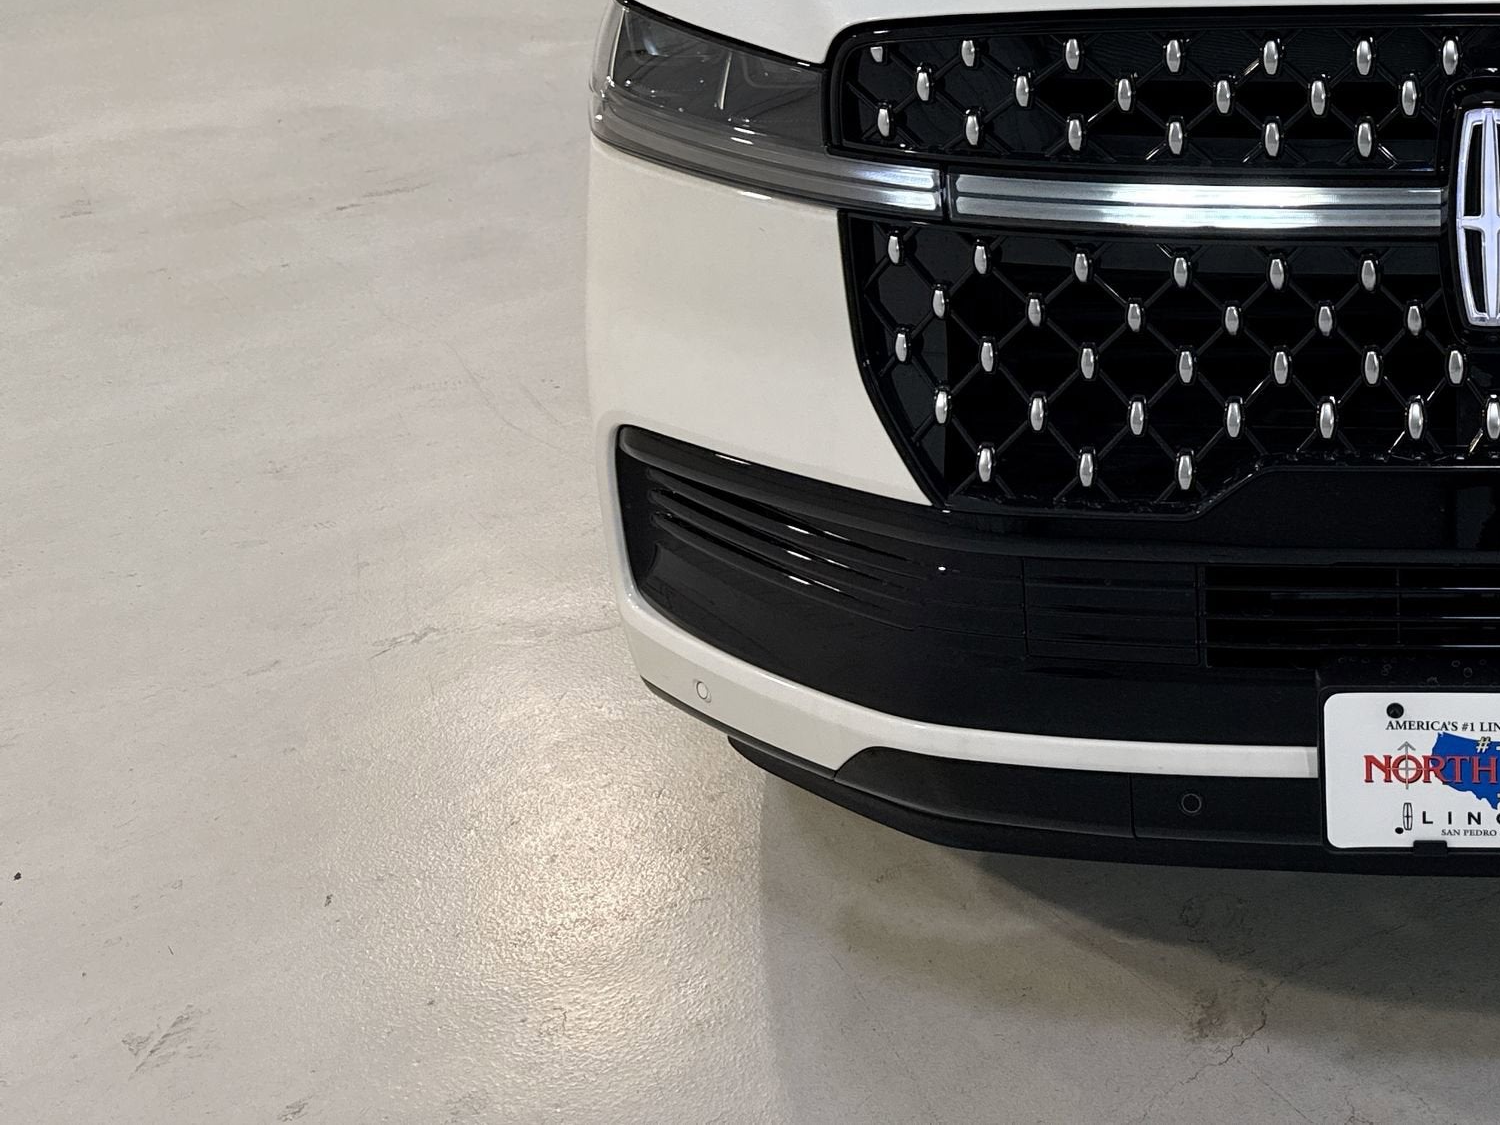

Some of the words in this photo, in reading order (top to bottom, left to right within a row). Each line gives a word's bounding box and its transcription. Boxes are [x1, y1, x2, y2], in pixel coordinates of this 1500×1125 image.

[1386, 720, 1459, 732] AMERICA'S
[1461, 722, 1475, 732] #1
[1363, 754, 1500, 785] NORTH
[1441, 828, 1461, 837] SAN
[1463, 829, 1497, 838] PEDRO
